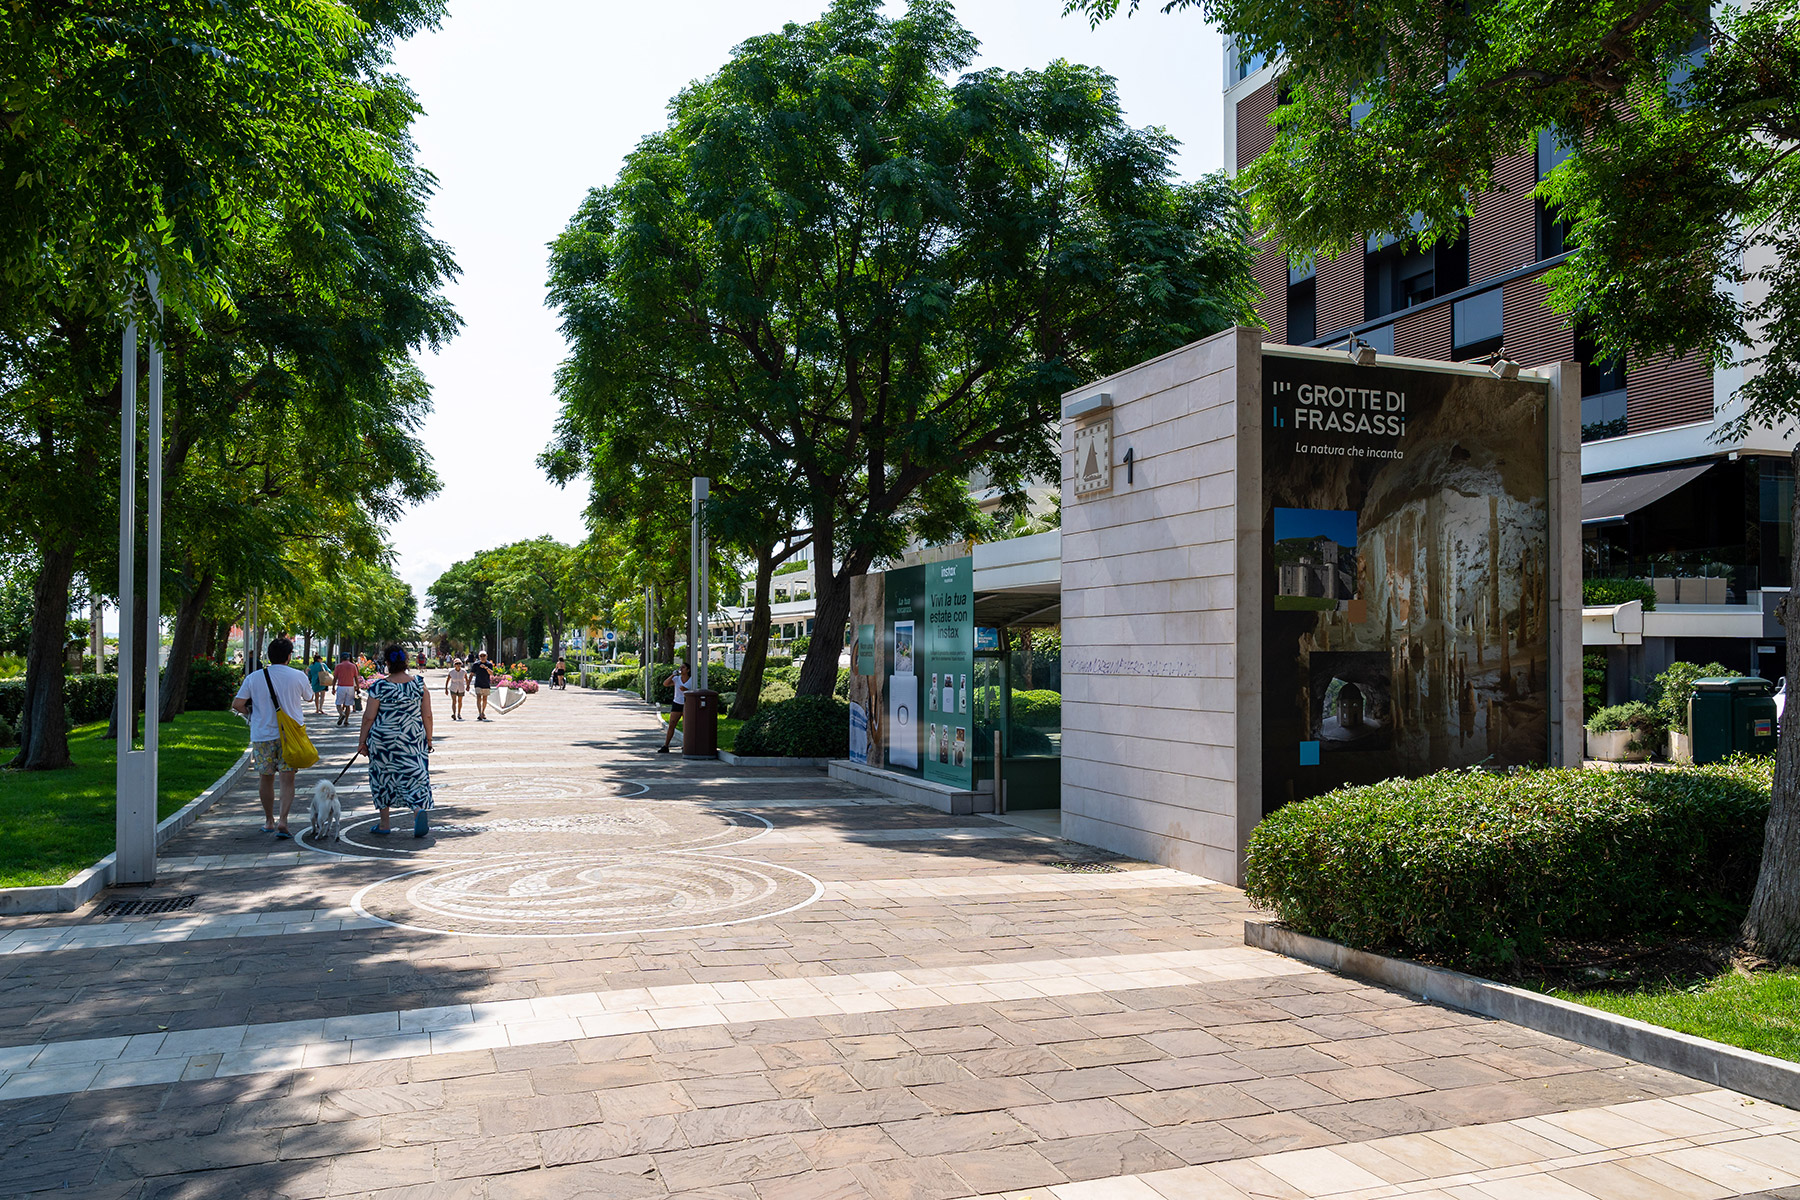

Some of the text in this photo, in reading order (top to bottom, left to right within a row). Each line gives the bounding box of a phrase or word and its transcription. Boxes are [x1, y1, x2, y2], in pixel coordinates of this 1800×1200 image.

[1297, 384, 1405, 412] GROTTE DI
[1296, 442, 1404, 459] La natura che incanta
[1122, 447, 1134, 484] 1
[931, 593, 967, 607] Vivi la tua
[930, 610, 967, 623] estate con
[937, 625, 959, 639] instax
